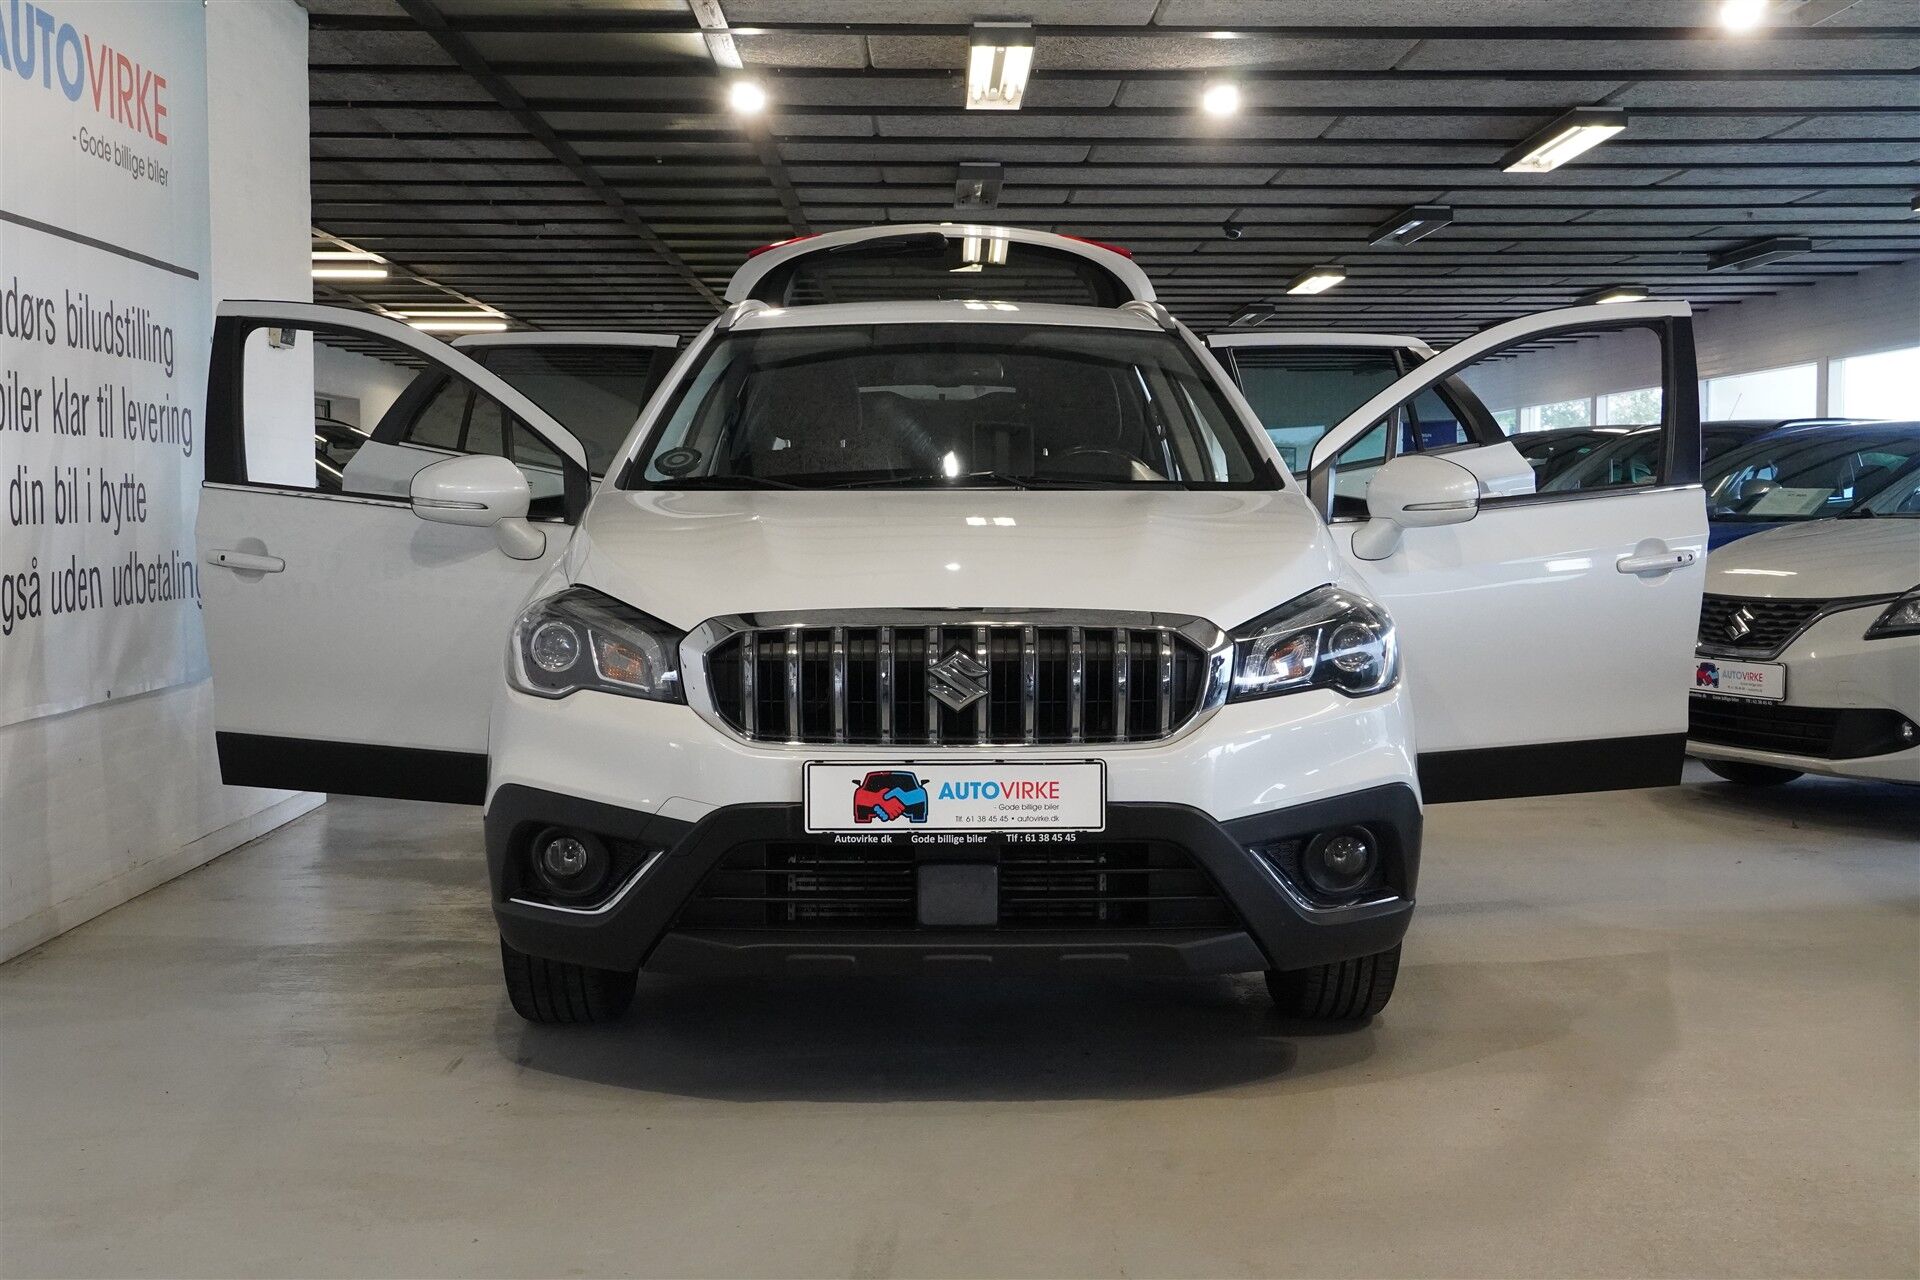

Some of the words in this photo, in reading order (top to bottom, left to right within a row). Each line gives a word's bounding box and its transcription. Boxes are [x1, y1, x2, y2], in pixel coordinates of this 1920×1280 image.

[79, 126, 112, 162] Gode
[114, 141, 145, 180] billige
[147, 156, 169, 187] biler
[65, 288, 174, 379] biludstilling
[52, 376, 90, 437] klar
[97, 383, 114, 439] til
[121, 386, 193, 458] levering
[9, 464, 44, 527] din
[54, 465, 78, 525] bil
[86, 467, 92, 523] i
[100, 467, 147, 536] bytte
[51, 554, 103, 615] uden
[1722, 670, 1763, 682] AUTOVIRKE
[938, 780, 1060, 800] AUTOVIRKE
[998, 803, 1020, 811] Gode
[1021, 803, 1042, 812] billige
[1044, 803, 1060, 811] biler
[1016, 815, 1060, 823] autovirke.dk
[834, 834, 879, 844] Autovirke
[880, 834, 893, 844] dk
[911, 834, 936, 844] Gode
[937, 834, 964, 845] billige
[966, 834, 988, 844] biler
[1006, 834, 1018, 843] Tlf
[1025, 834, 1037, 843] 61
[1038, 834, 1051, 843] 38
[1051, 833, 1064, 843] 45
[1064, 833, 1077, 843] 45
